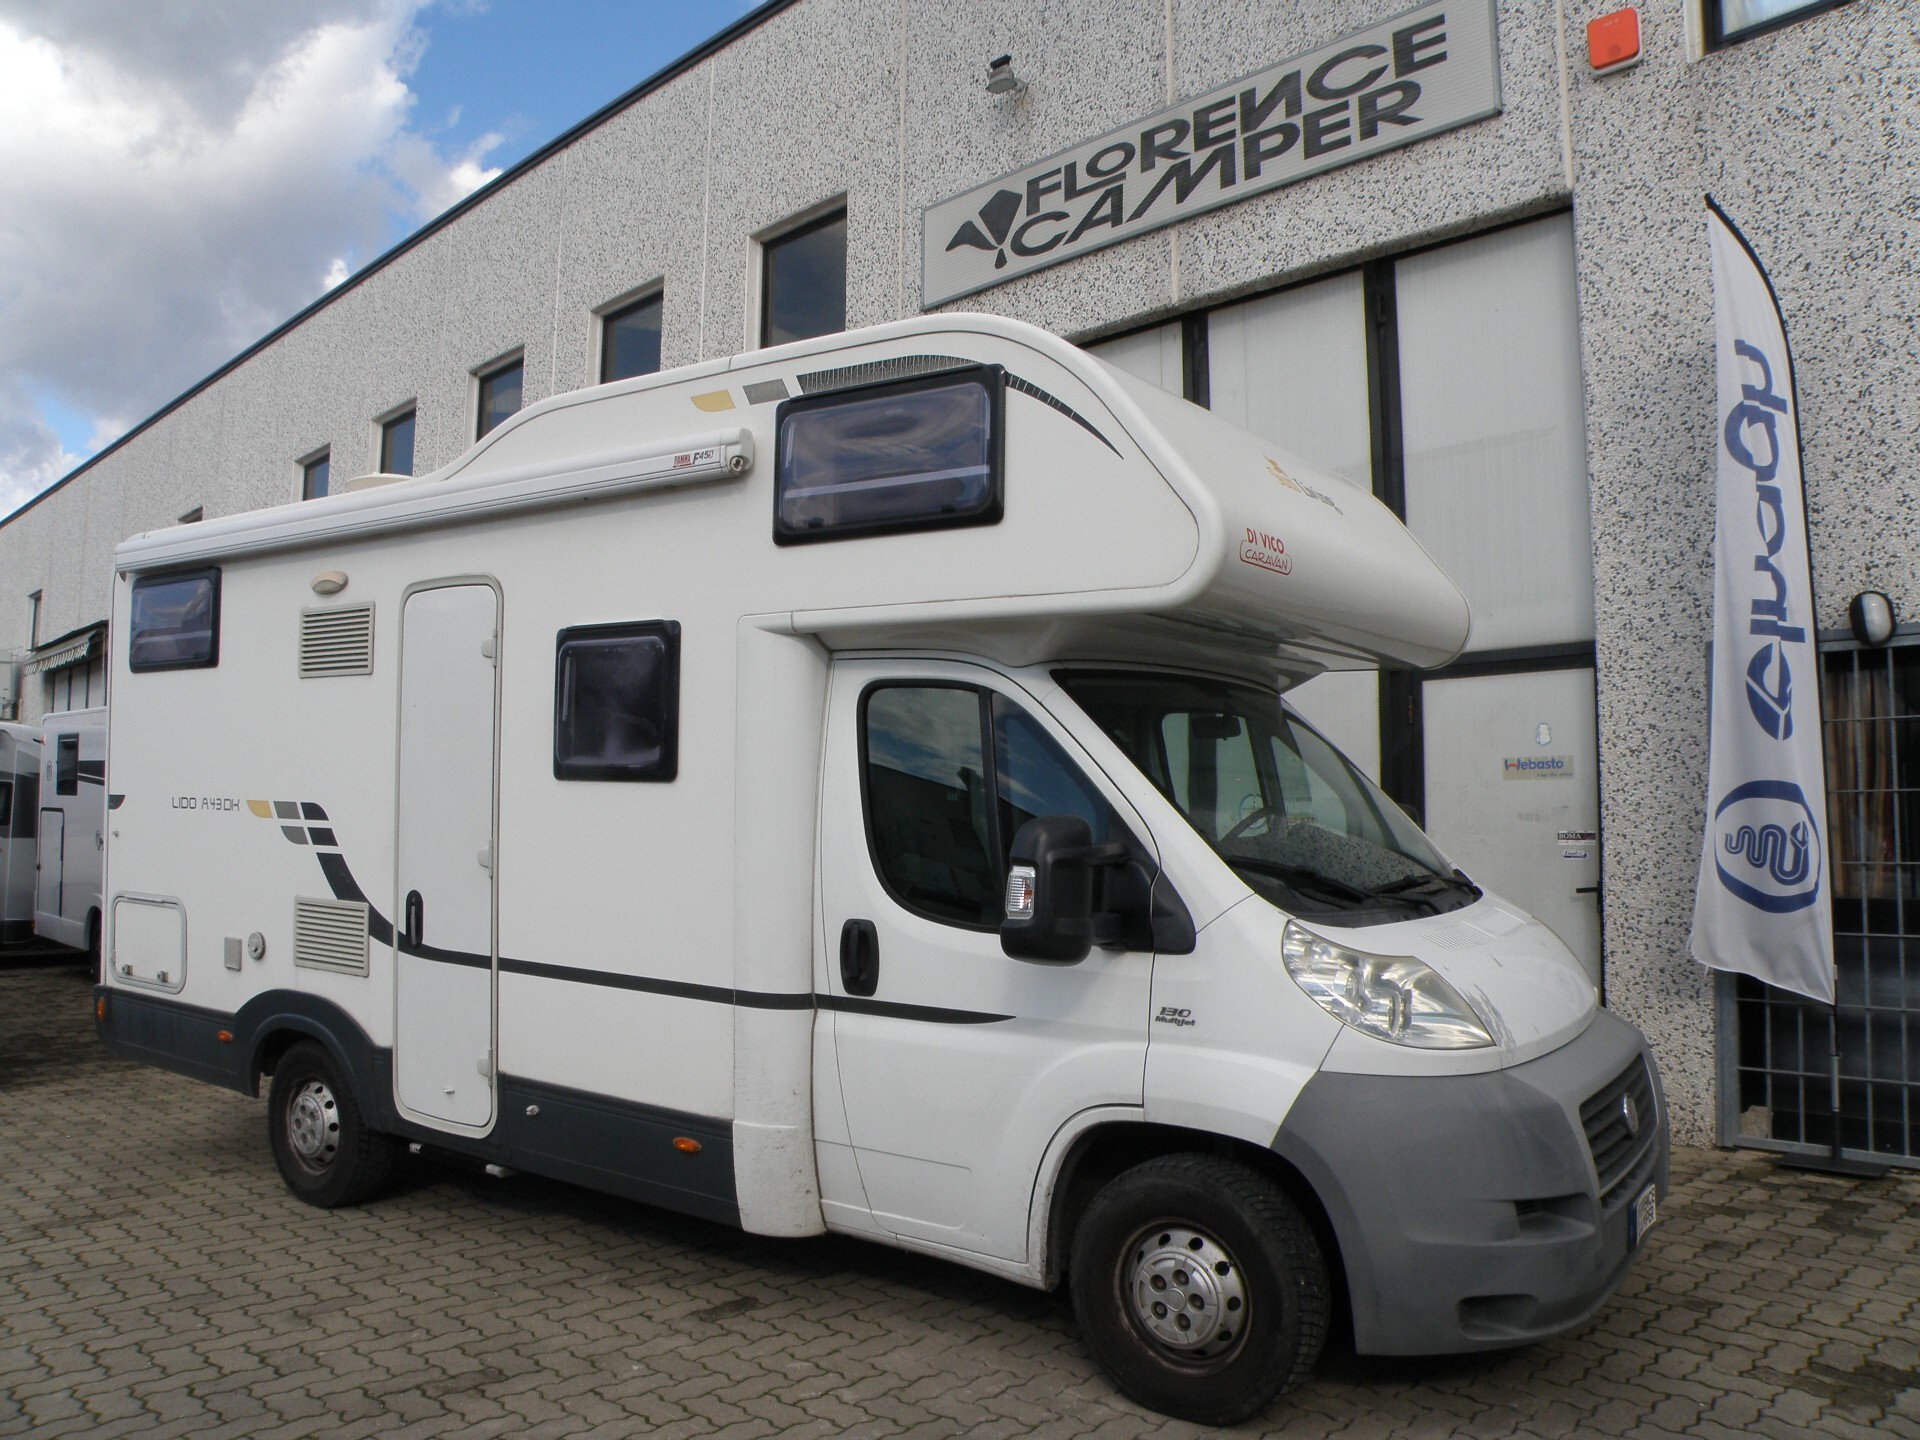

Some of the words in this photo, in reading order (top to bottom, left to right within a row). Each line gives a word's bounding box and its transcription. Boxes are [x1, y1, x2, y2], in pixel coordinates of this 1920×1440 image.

[1025, 13, 1447, 217] FLORENCE
[1010, 80, 1423, 257] CAMPER
[1245, 527, 1258, 546] DI
[1259, 531, 1285, 555] VICO
[1245, 549, 1289, 571] CARAVAN
[1504, 757, 1564, 771] Webasto
[172, 796, 197, 810] LIDO
[1159, 1006, 1192, 1018] 130
